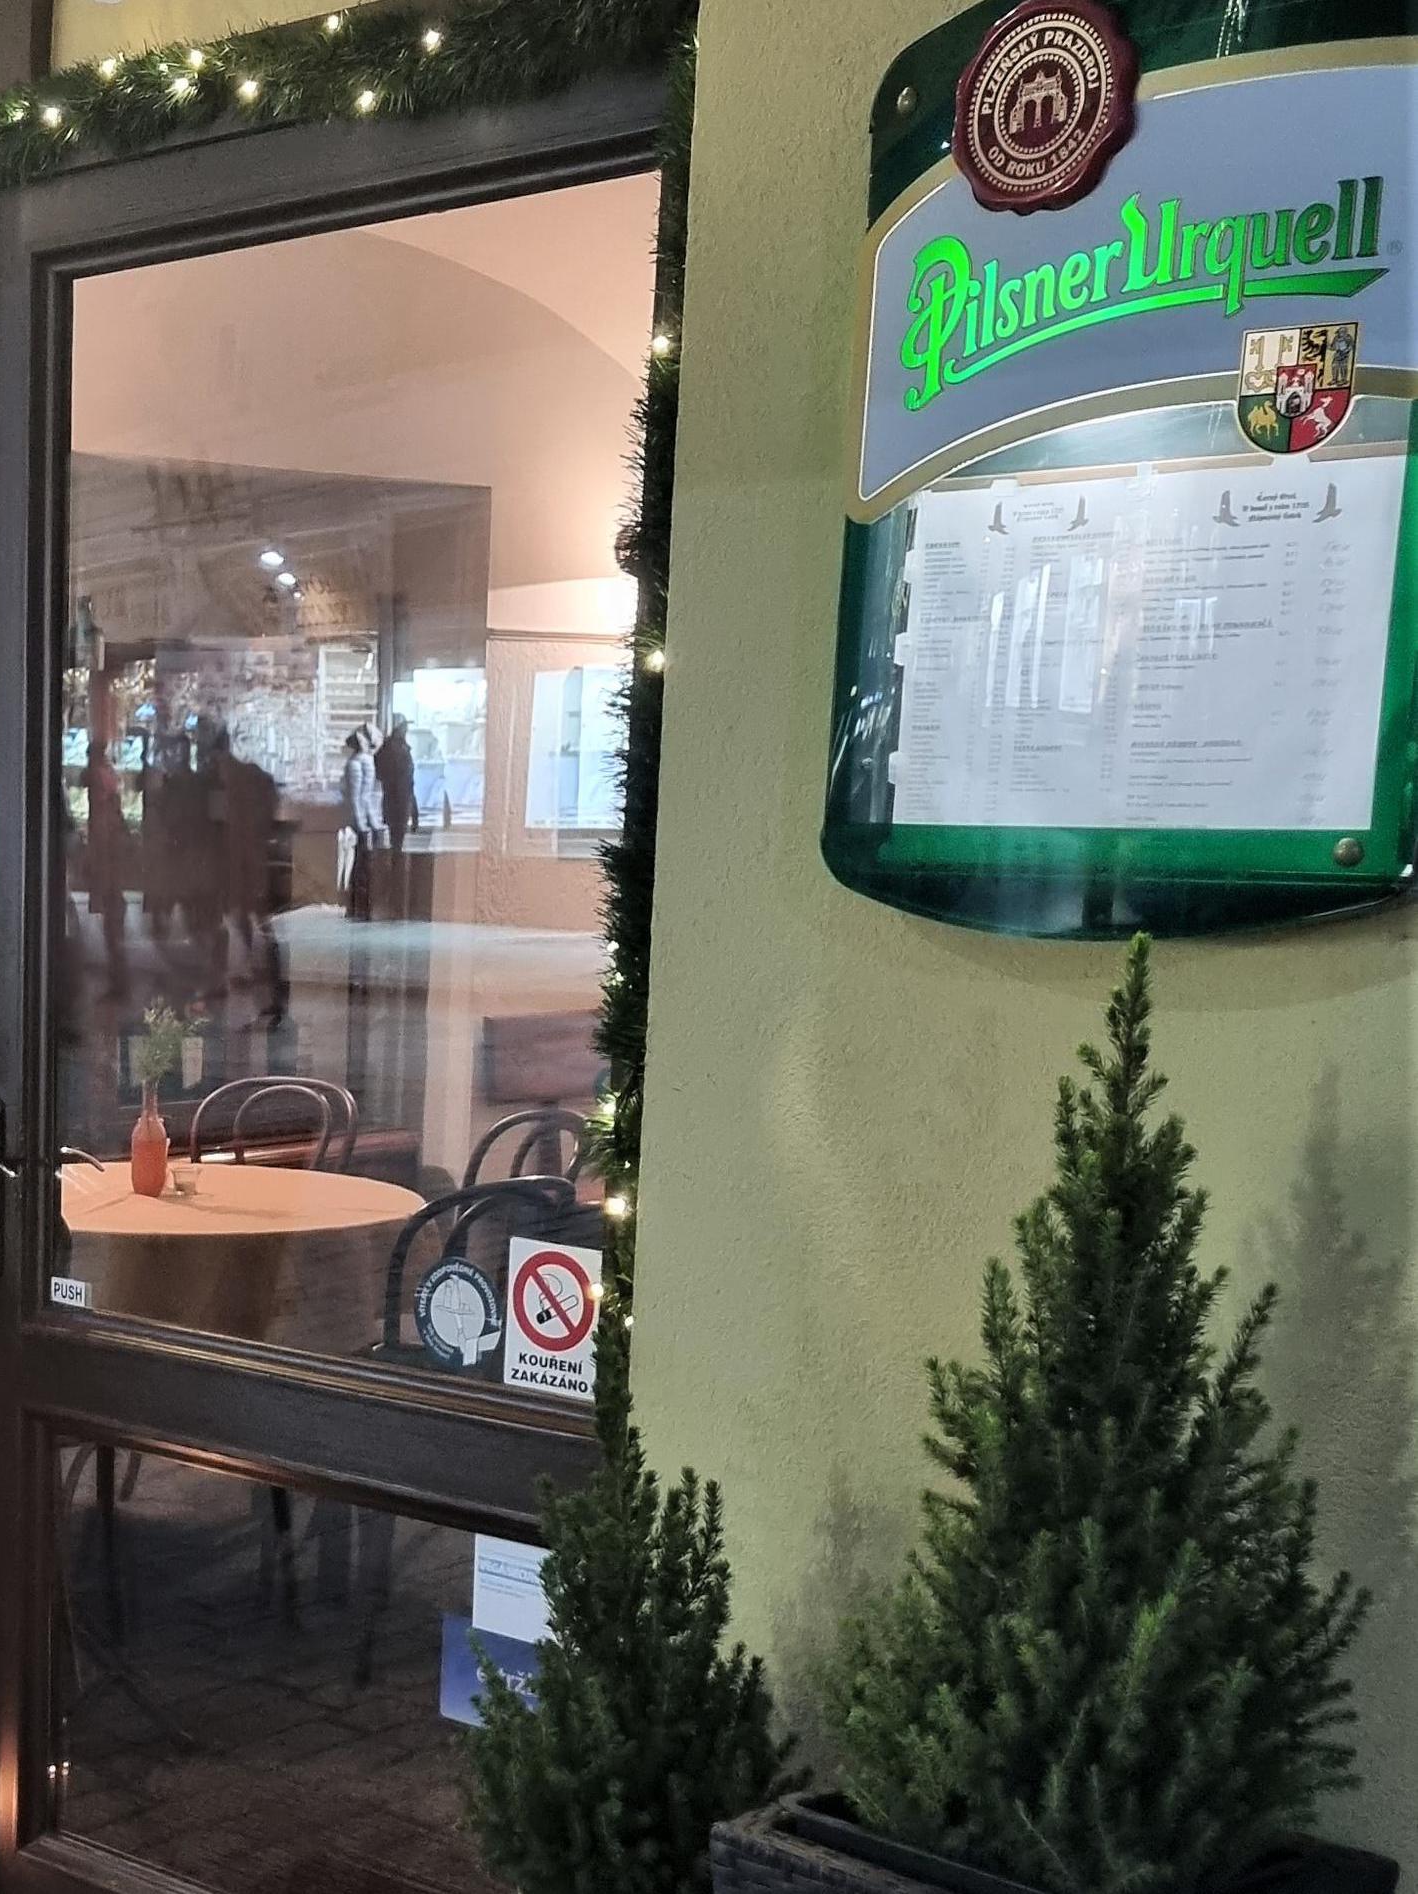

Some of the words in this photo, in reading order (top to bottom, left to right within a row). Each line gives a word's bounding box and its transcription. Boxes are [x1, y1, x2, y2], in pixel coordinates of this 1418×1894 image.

[1044, 31, 1100, 89] PRAZDROJ
[988, 145, 1005, 166] OD
[1006, 160, 1046, 177] ROKU
[1051, 129, 1085, 167] 1842
[901, 235, 1124, 411] Pilsner
[1120, 176, 1385, 317] Urquell
[54, 1282, 83, 1302] PUSH
[511, 1367, 589, 1393] ZAKÁZÁNO
[518, 1352, 583, 1375] KOUŘENÍ
